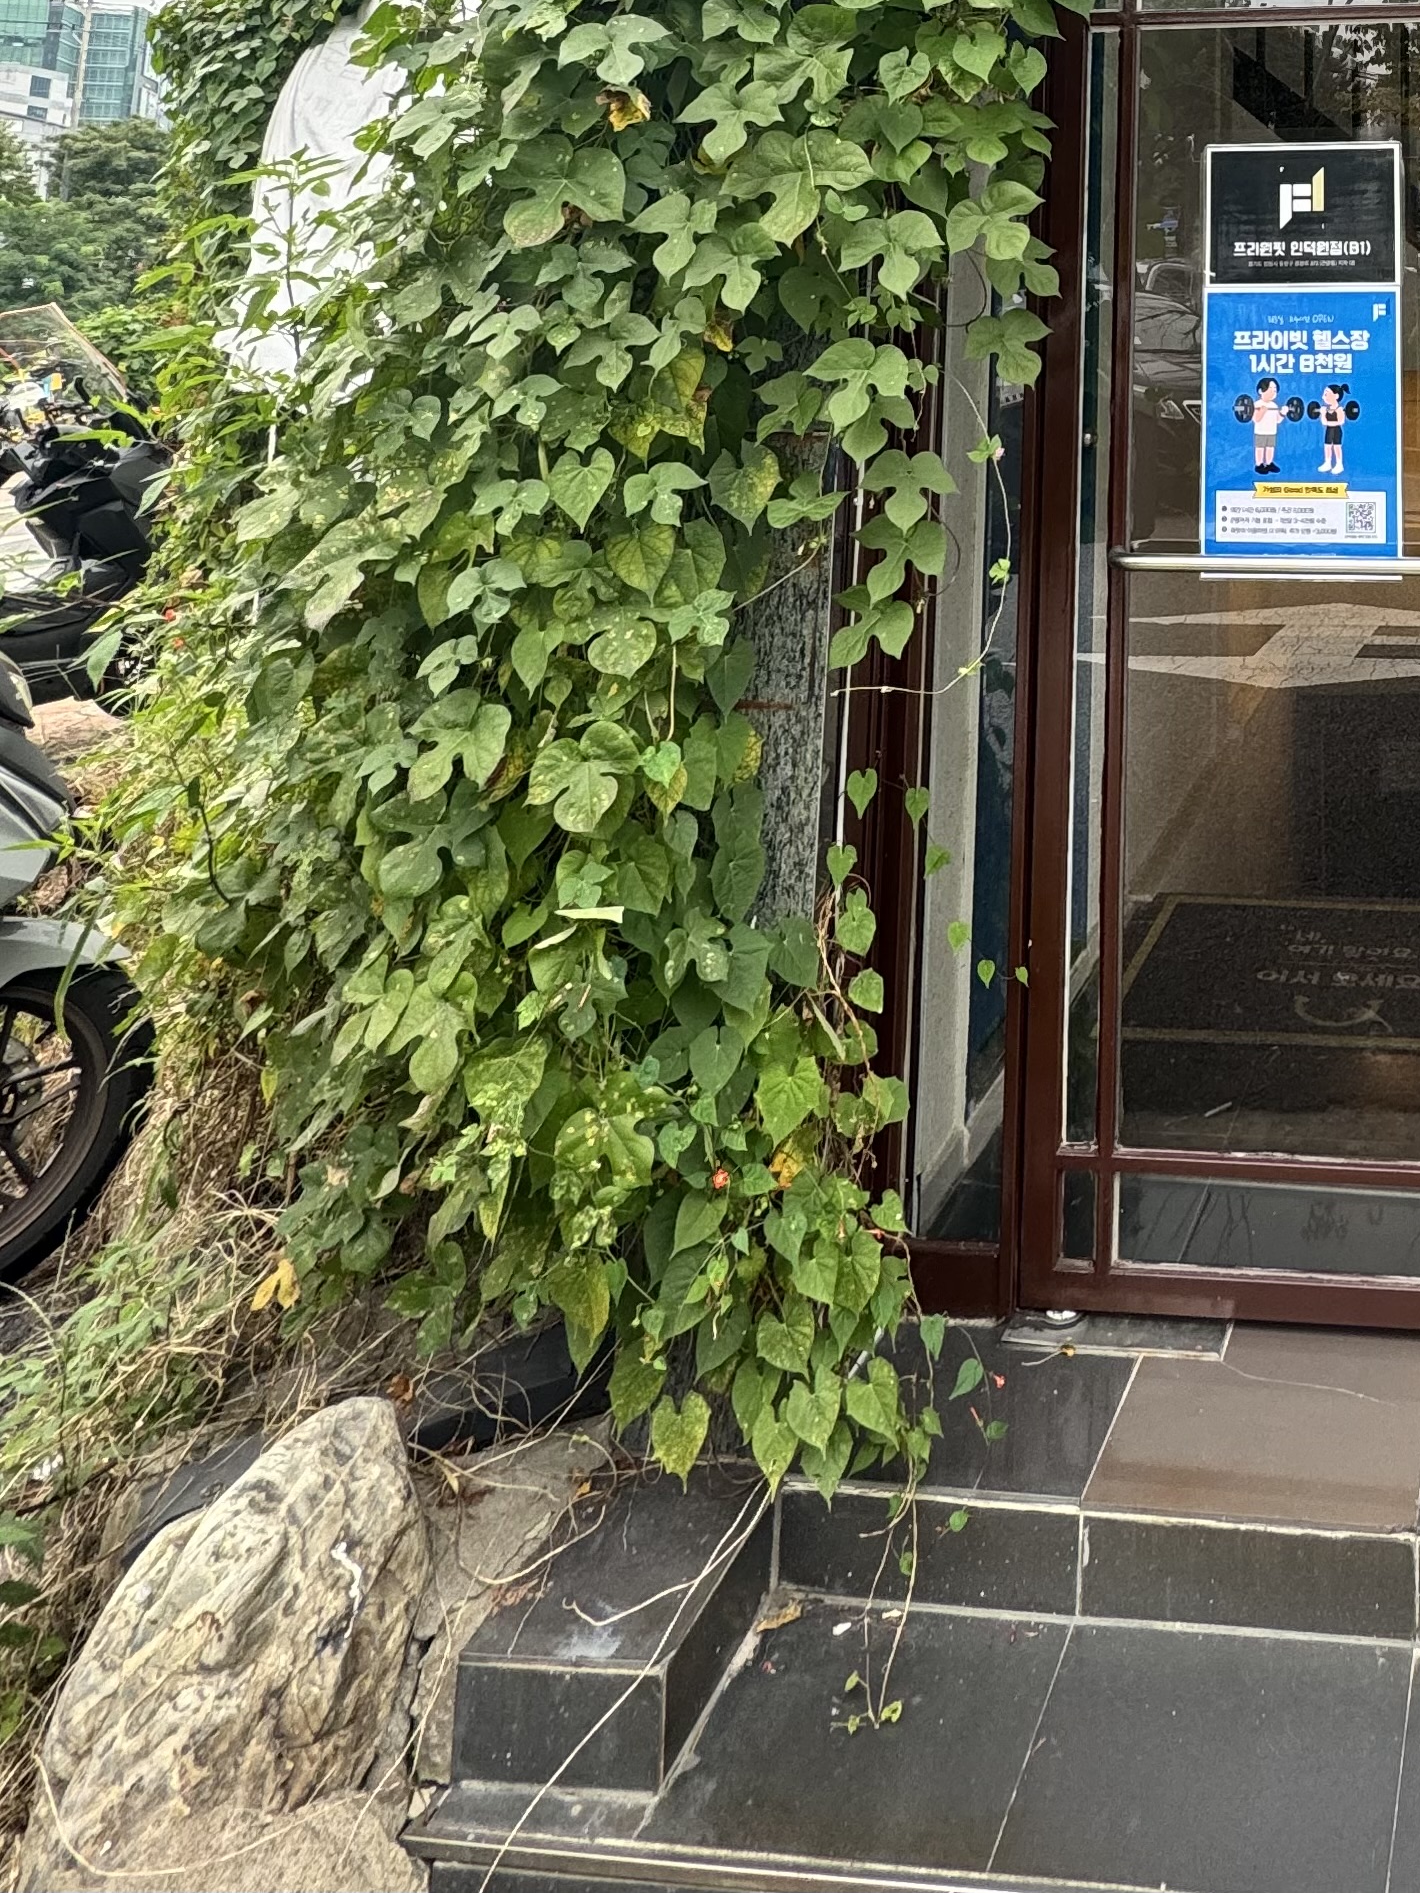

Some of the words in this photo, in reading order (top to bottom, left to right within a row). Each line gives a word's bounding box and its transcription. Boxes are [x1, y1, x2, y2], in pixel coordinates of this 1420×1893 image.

[1233, 241, 1286, 256] 프리원핏
[1290, 240, 1372, 256] 인덕원점(B1)
[1233, 330, 1309, 350] 프라이빗
[1312, 329, 1371, 350] 헬스장
[1249, 353, 1296, 374] 1시간
[1299, 353, 1353, 374] 8천원
